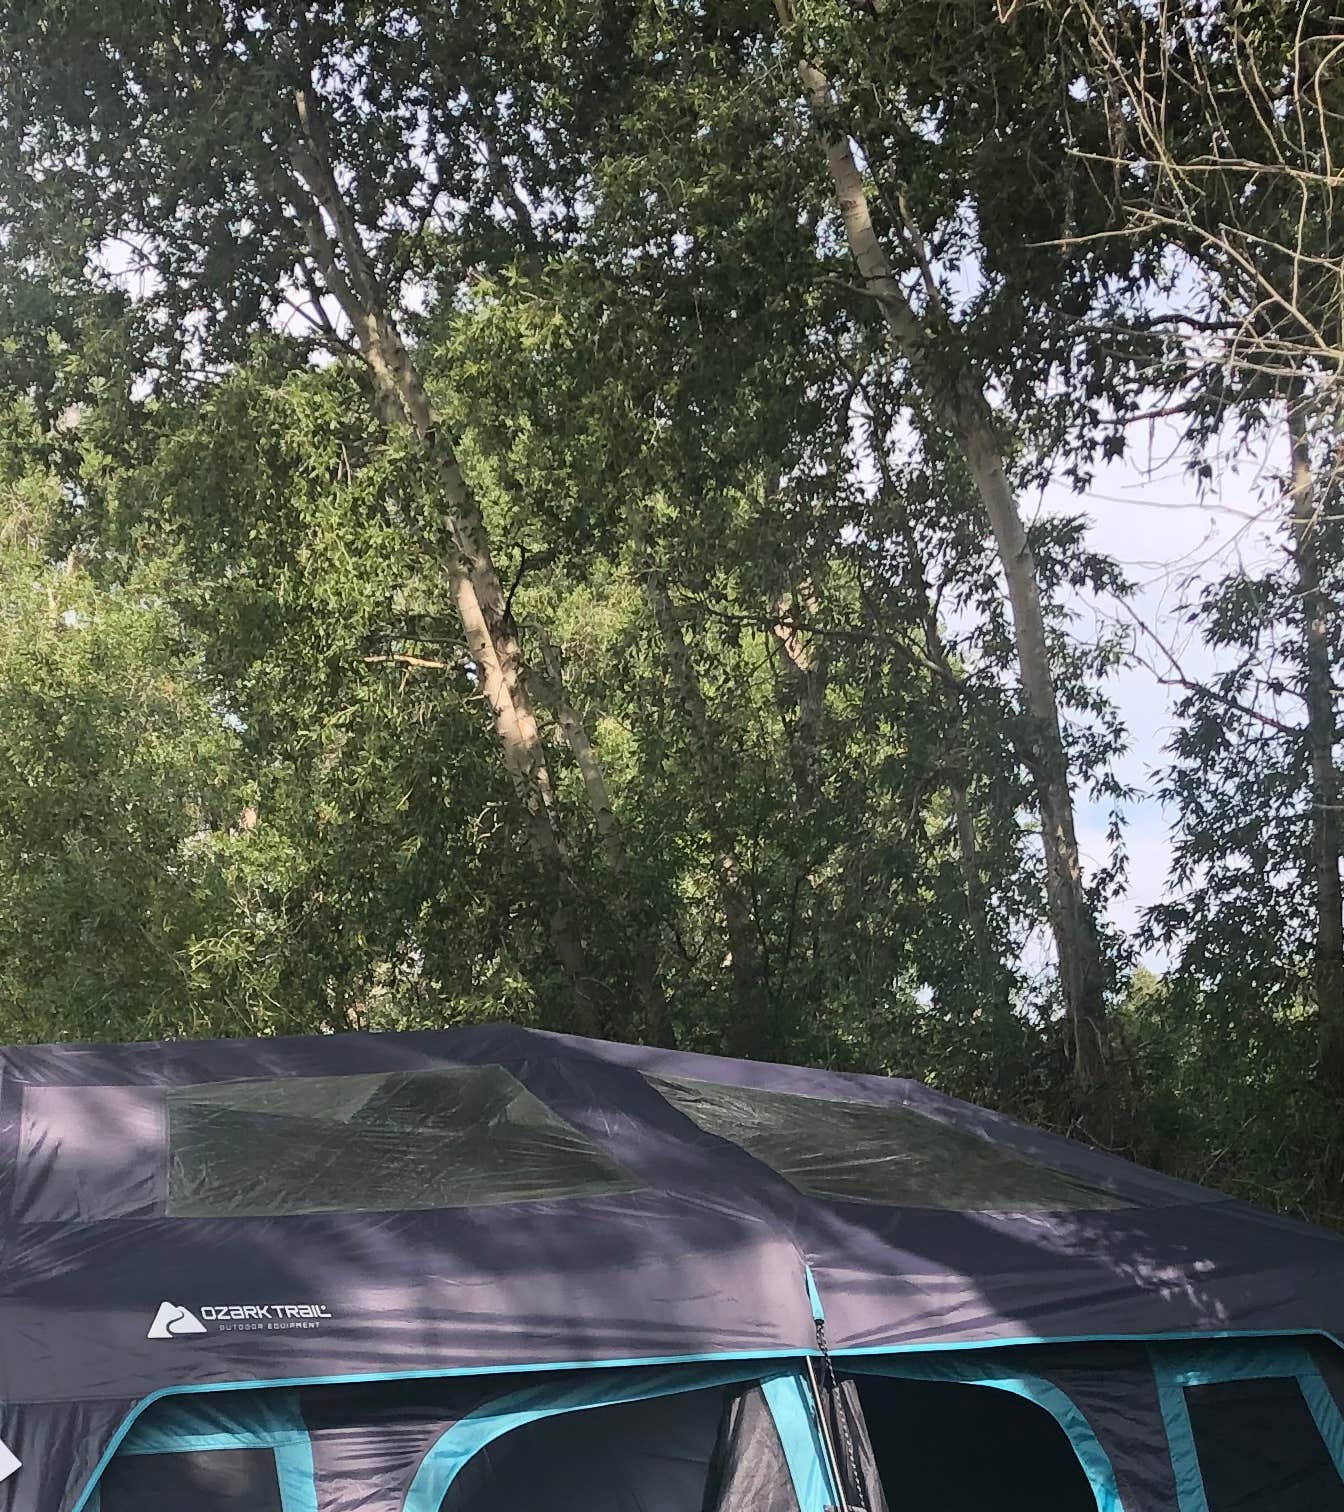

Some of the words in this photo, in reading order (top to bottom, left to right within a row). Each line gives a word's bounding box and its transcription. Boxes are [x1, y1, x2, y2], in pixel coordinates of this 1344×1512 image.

[200, 1305, 272, 1320] OZARK
[271, 1304, 332, 1318] TRAIL
[267, 1322, 321, 1330] EQUIPMENT
